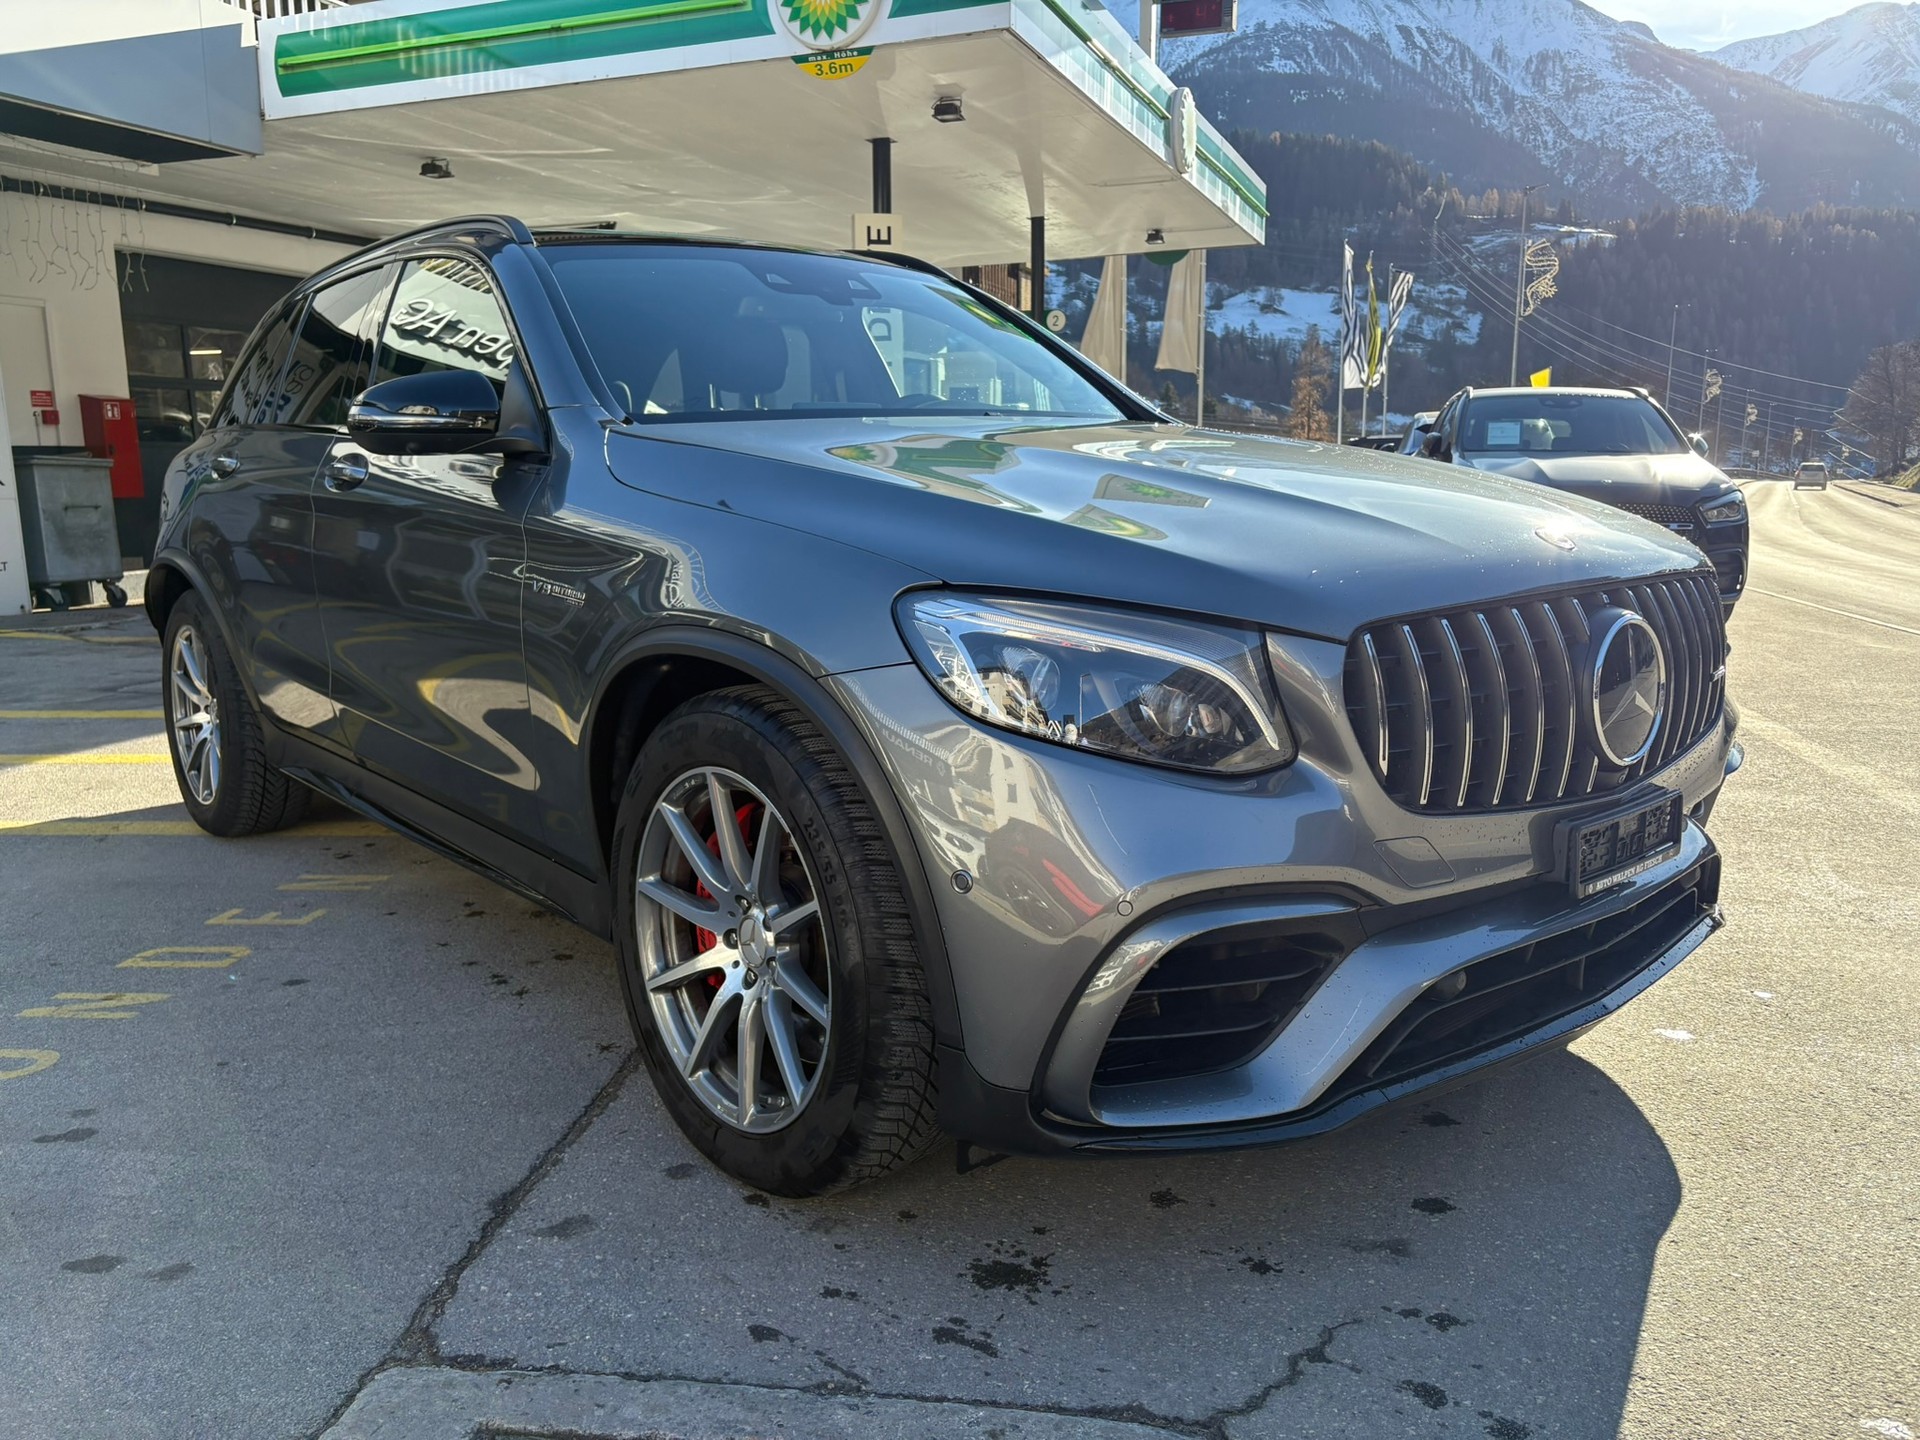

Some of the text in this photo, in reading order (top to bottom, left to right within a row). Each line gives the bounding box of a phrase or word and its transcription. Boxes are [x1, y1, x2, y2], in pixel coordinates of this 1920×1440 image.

[808, 50, 858, 62] max. Höhe
[814, 61, 854, 77] 3.6m
[1052, 314, 1060, 327] 2
[532, 580, 551, 595] V8
[803, 817, 838, 886] 235/55
[1595, 876, 1612, 890] AUTO
